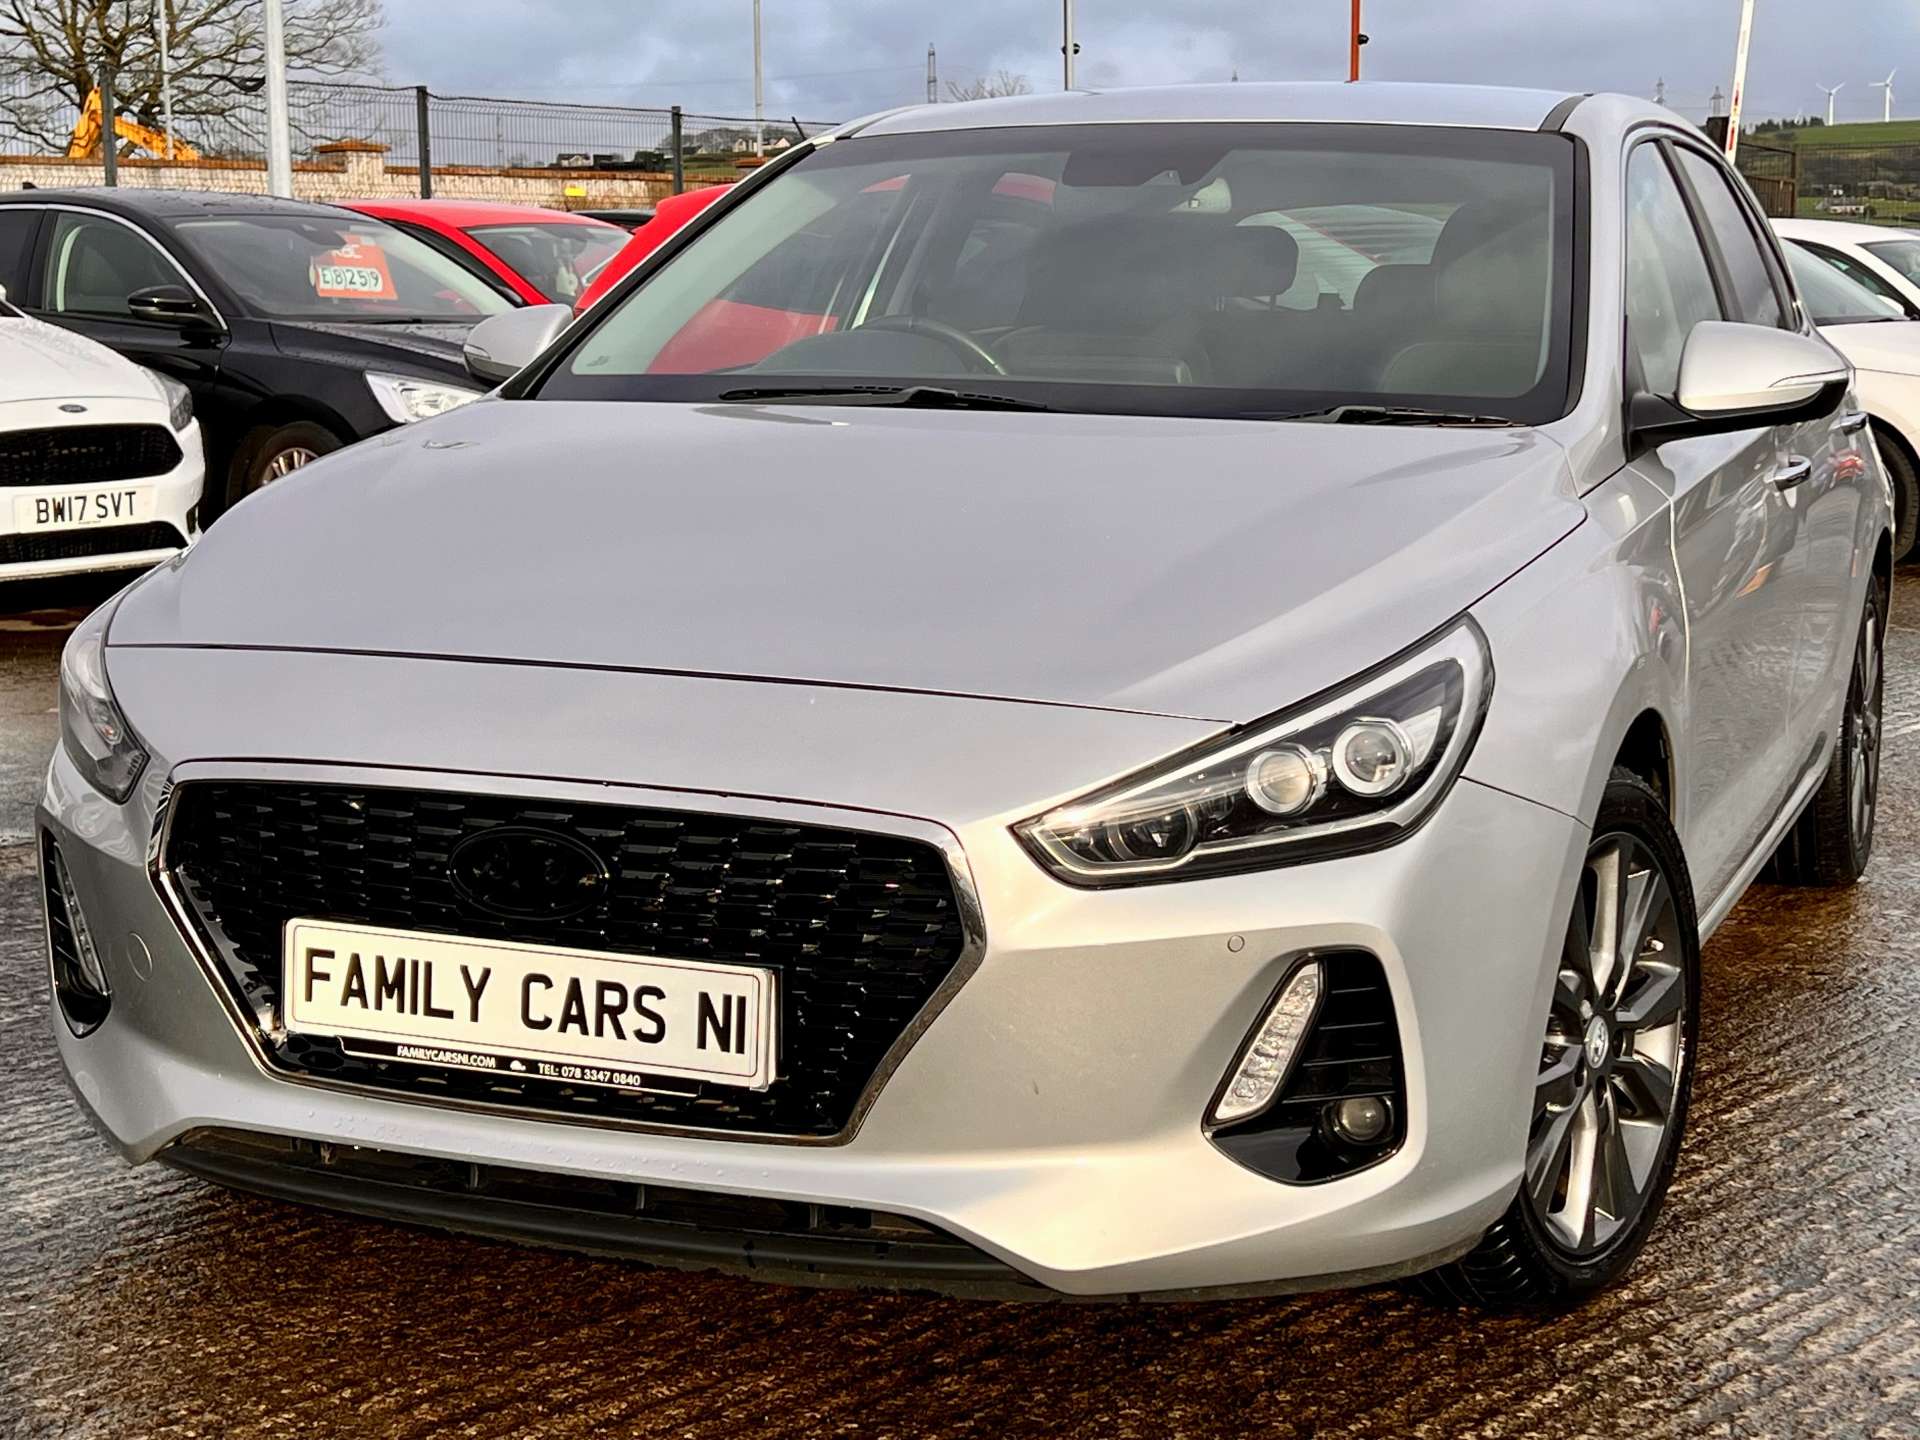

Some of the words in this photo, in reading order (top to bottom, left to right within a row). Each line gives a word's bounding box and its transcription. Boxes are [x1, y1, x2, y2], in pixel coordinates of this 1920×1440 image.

[35, 496, 88, 524] BW17
[95, 491, 137, 519] SVT
[304, 946, 492, 1023] FAMILY
[520, 972, 667, 1045] CARS
[396, 1045, 497, 1069] FAMILYCARSNI.COM
[537, 1062, 560, 1077] TEL:
[561, 1065, 582, 1079] 078
[583, 1068, 611, 1083] 3347
[612, 1072, 641, 1087] 0840
